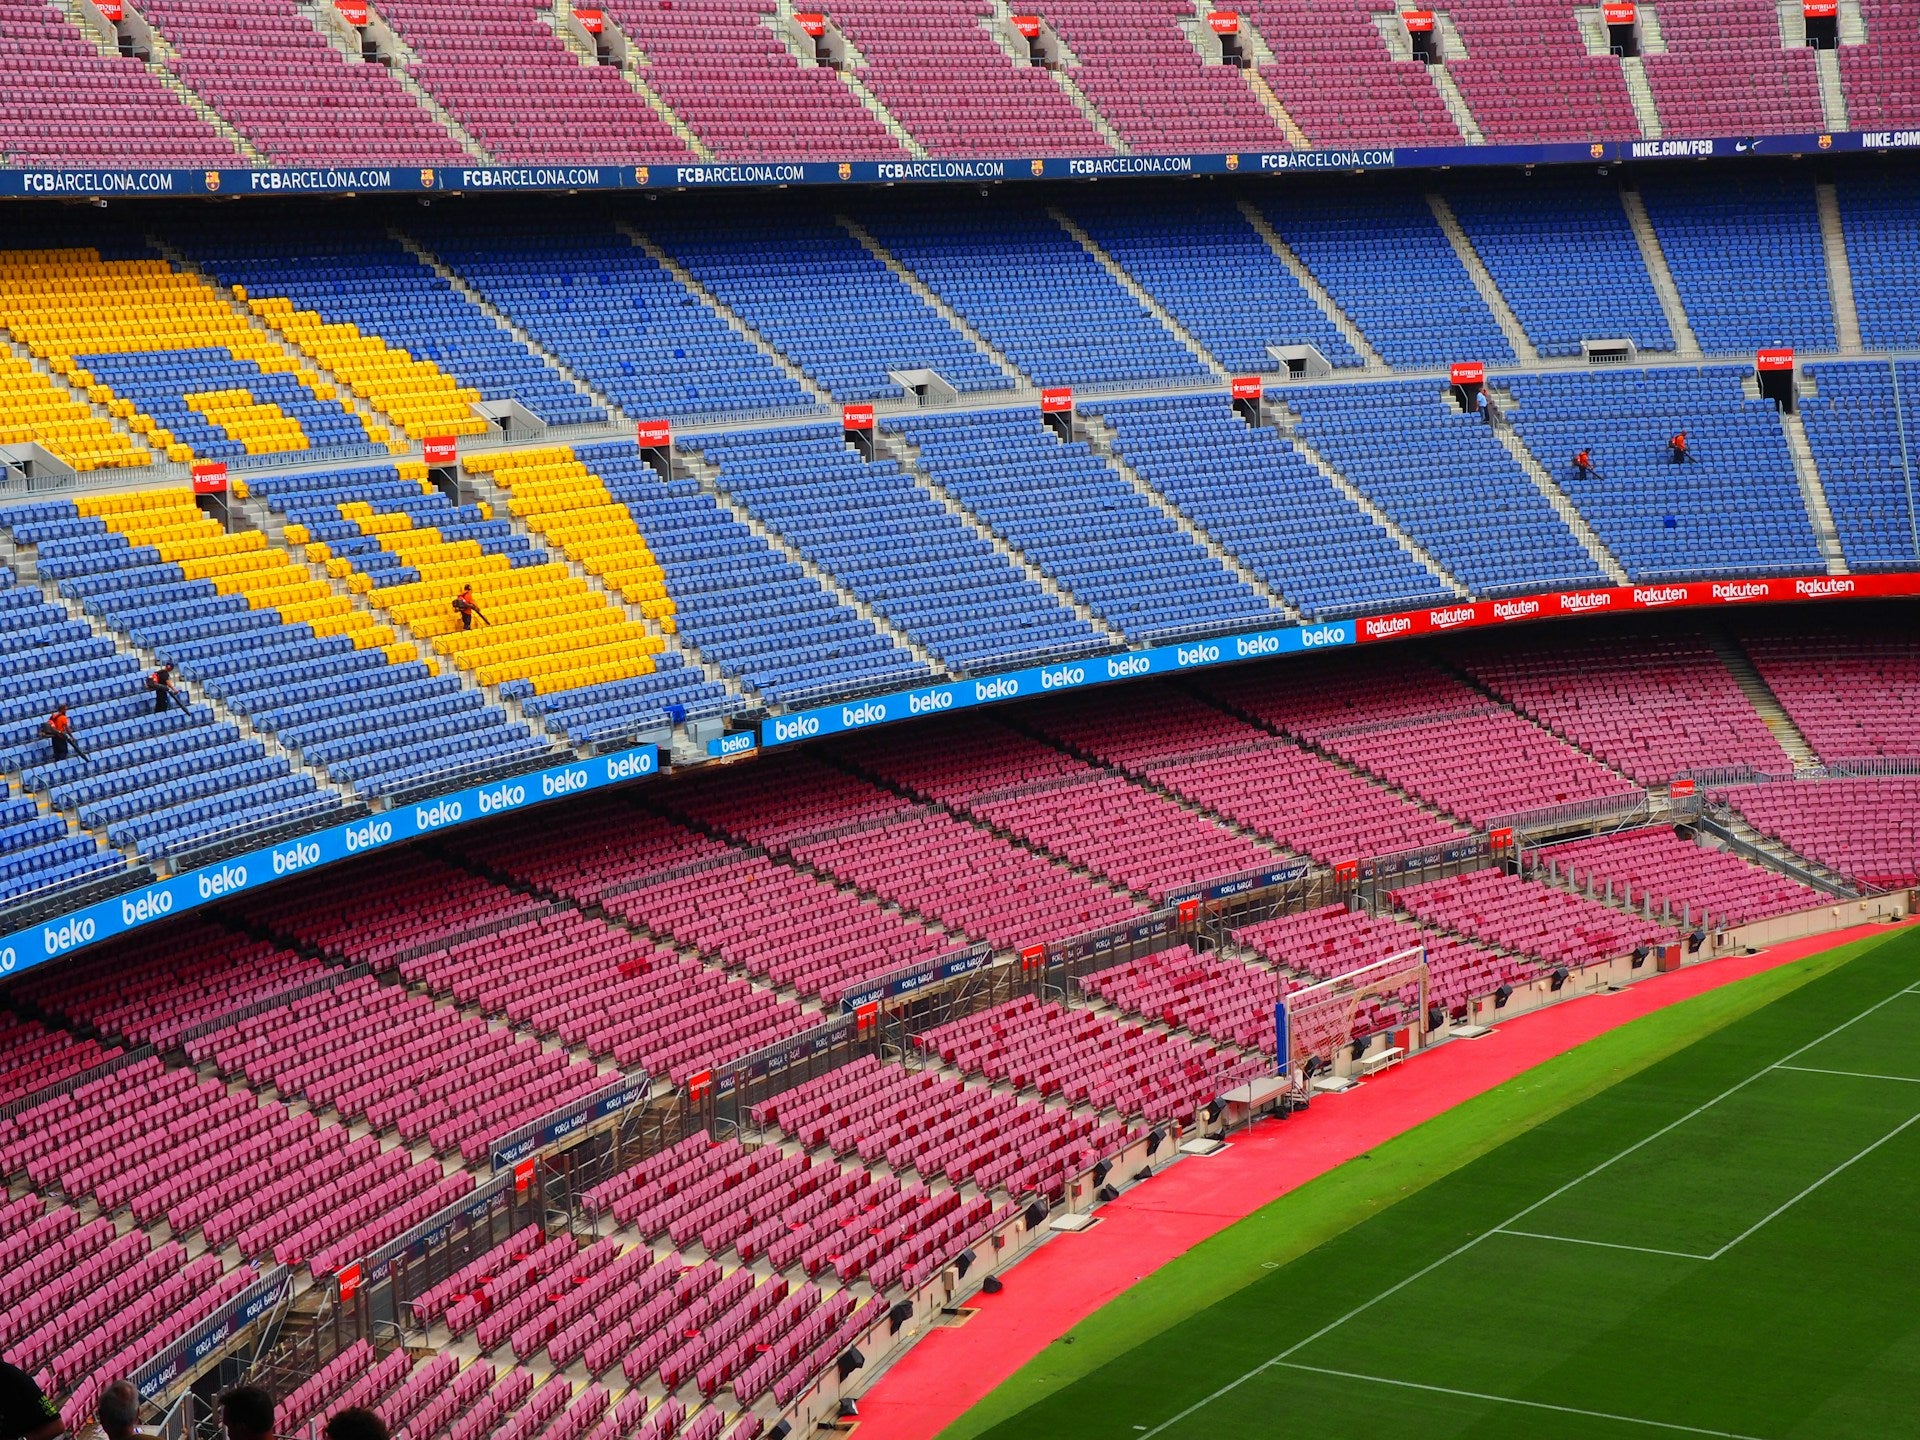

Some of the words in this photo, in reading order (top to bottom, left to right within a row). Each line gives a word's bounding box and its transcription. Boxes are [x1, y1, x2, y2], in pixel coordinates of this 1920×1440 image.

[1632, 140, 1712, 157] NIKE.COM/FCB
[1862, 131, 1920, 147] NIKE.COM
[1069, 157, 1191, 173] FCBARCELONA.COM
[1261, 150, 1393, 168] FCBARCELONA.COM
[252, 170, 390, 189] FCBARCELONA.COM
[463, 168, 598, 186] FCBARCELONA.COM
[677, 164, 803, 182] FCBARCELONA.COM
[877, 161, 1003, 178] FCBARCELONA.COM
[24, 173, 172, 191] FCBARCELONA.COM
[1459, 368, 1483, 377] ESTRELLA
[1049, 395, 1071, 403] ESTRELLA
[851, 413, 873, 421] ESTRELLA
[646, 429, 669, 437] ESTRELLA
[431, 444, 455, 454] ESTRELLA
[201, 474, 226, 483] ESTRELLA
[1633, 586, 1687, 606] Rakuten
[1713, 583, 1768, 601] Rakuten
[1797, 578, 1854, 597] Rakuten
[1494, 599, 1538, 620] Rakuten
[1561, 593, 1610, 612] Rakuten
[1367, 616, 1410, 638] Rakuten
[1431, 607, 1474, 629] Rakuten
[1237, 635, 1278, 656] beko
[1302, 626, 1344, 646] beko
[1178, 644, 1219, 666] beko
[1040, 665, 1085, 688] beko
[1107, 655, 1149, 678] beko
[975, 677, 1018, 699] beko
[909, 690, 952, 713] beko
[842, 703, 886, 727] beko
[775, 714, 819, 740] beko
[721, 736, 750, 753] beko
[608, 753, 650, 780] beko
[542, 768, 588, 797] beko
[478, 784, 525, 813] beko
[416, 800, 462, 830] beko
[346, 820, 391, 851] beko
[273, 842, 320, 875] beko
[1408, 858, 1421, 868] FORÇ
[199, 866, 247, 898] beko
[123, 890, 172, 925] beko
[44, 917, 95, 954] beko
[1113, 932, 1128, 944] ARÇA!
[902, 979, 916, 990] FORÇA
[916, 971, 933, 984] BARÇA!
[816, 1035, 829, 1048] FORÇ
[555, 1122, 570, 1135] FORÇA
[570, 1111, 587, 1128] BARÇA!
[247, 1303, 262, 1317] FORÇA
[263, 1285, 280, 1306] BARÇA!
[196, 1341, 211, 1356] FORÇA
[212, 1323, 229, 1346] BARÇA!
[158, 1362, 177, 1383] BARÇA!
